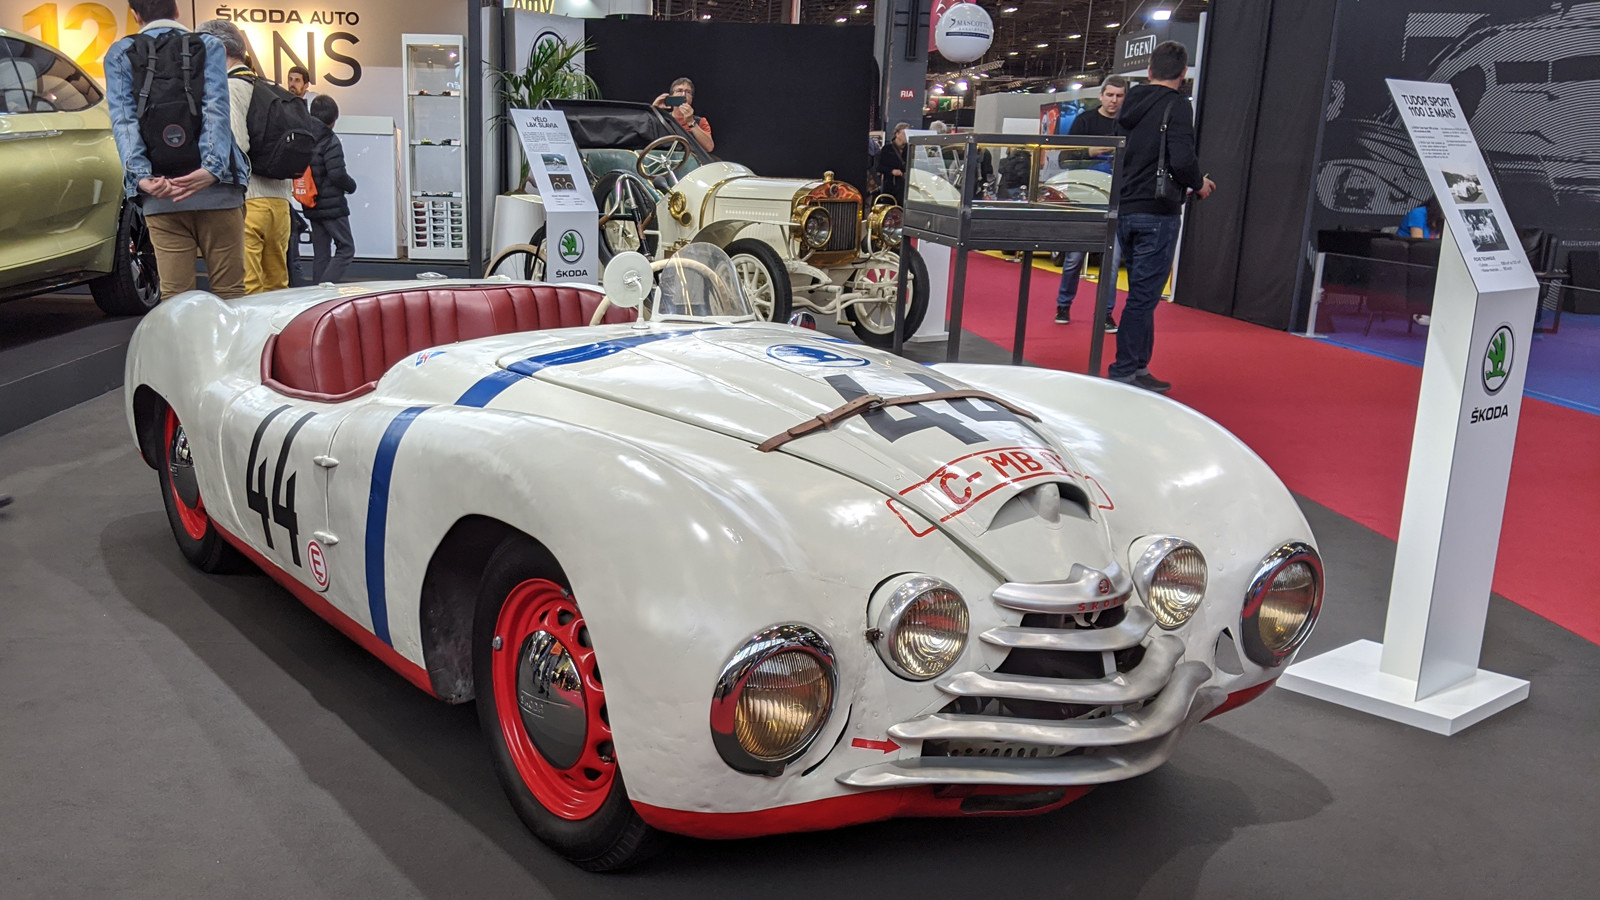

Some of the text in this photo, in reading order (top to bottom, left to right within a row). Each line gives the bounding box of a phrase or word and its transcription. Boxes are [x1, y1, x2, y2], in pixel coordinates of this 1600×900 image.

[216, 5, 360, 26] ŠKODA AUTO
[22, 2, 139, 78] 12
[900, 90, 914, 98] RIA
[1401, 94, 1452, 107] TUDOR SPORT
[1408, 106, 1456, 119] 1100 LE MANS
[555, 269, 588, 278] ŠKODA
[823, 373, 1052, 445] 44
[1470, 404, 1509, 424] ŠKODA
[246, 404, 319, 568] 44
[310, 547, 324, 580] E
